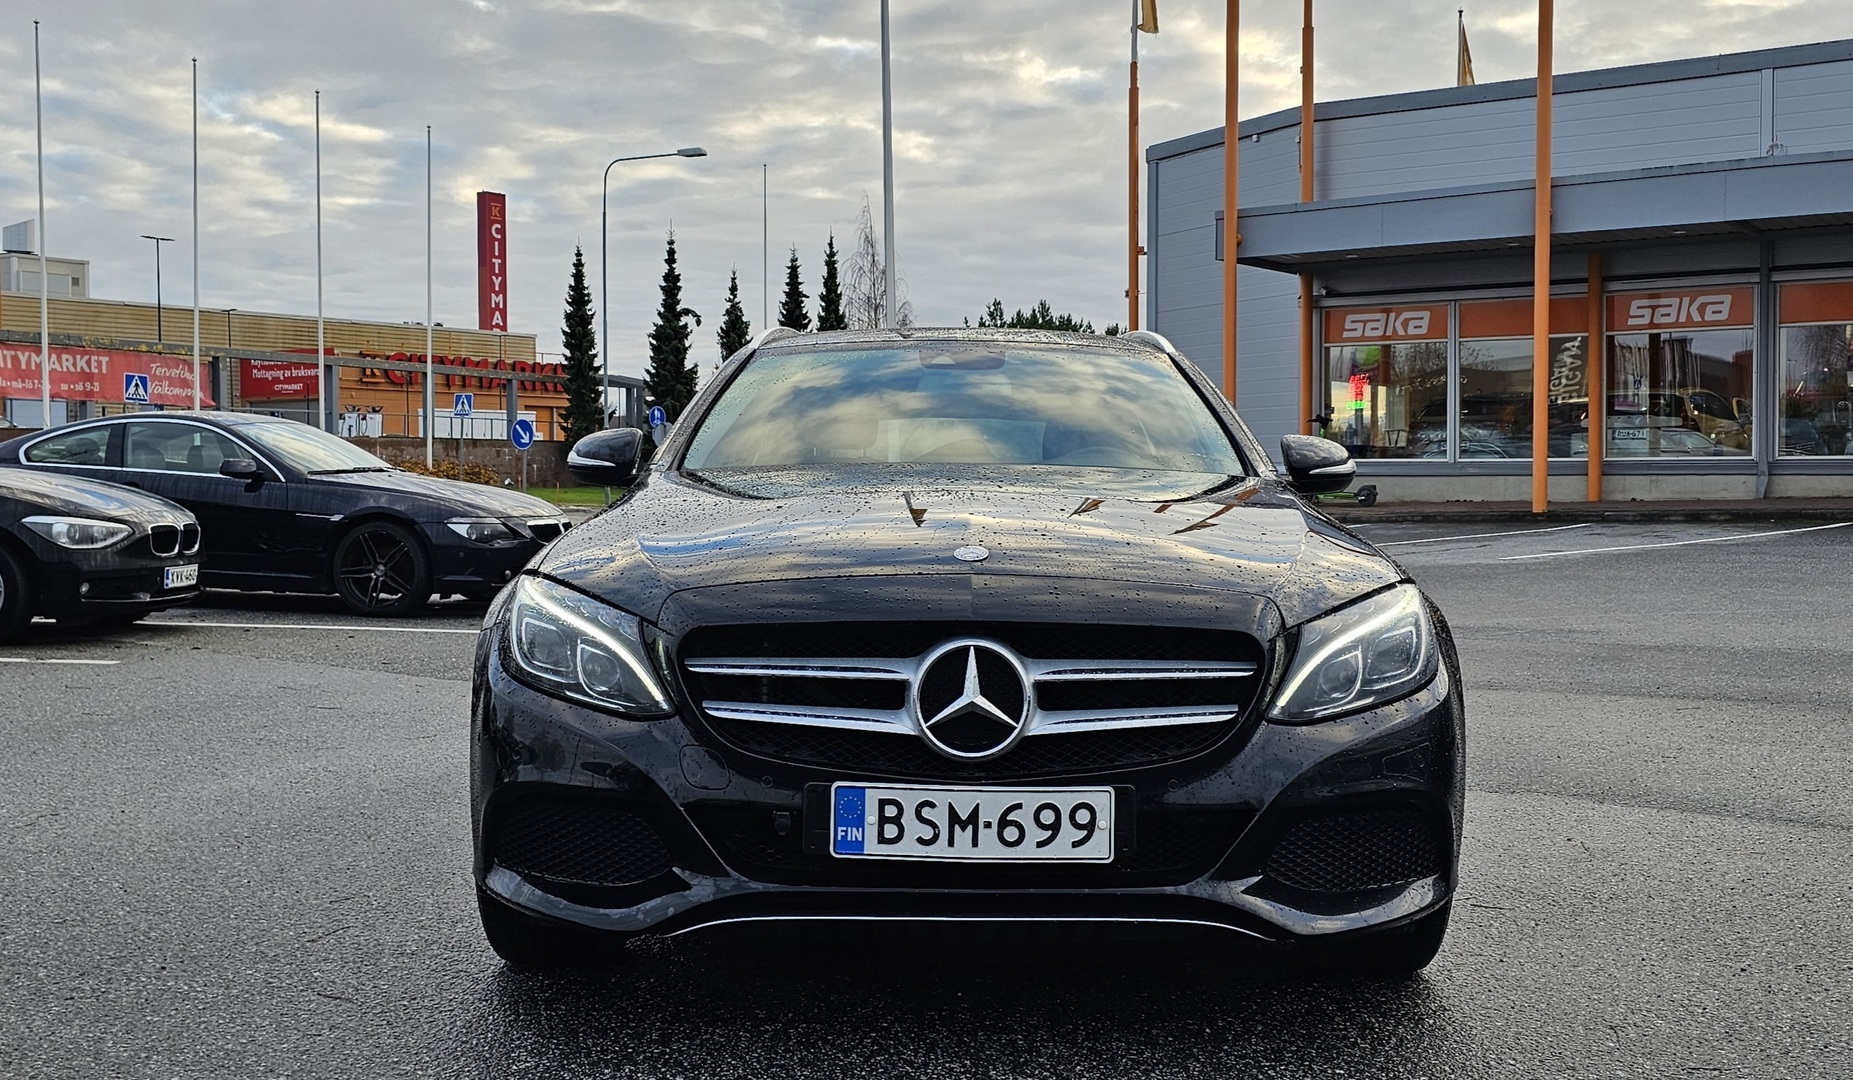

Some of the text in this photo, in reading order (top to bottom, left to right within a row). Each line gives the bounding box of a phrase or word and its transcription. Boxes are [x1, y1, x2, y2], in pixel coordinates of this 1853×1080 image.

[490, 223, 504, 332] CITYMA
[149, 380, 205, 400] Välkommn
[274, 383, 303, 391] CITYMARKET
[387, 352, 565, 392] CITYMARK
[837, 796, 1098, 849] FIN BSM-699
